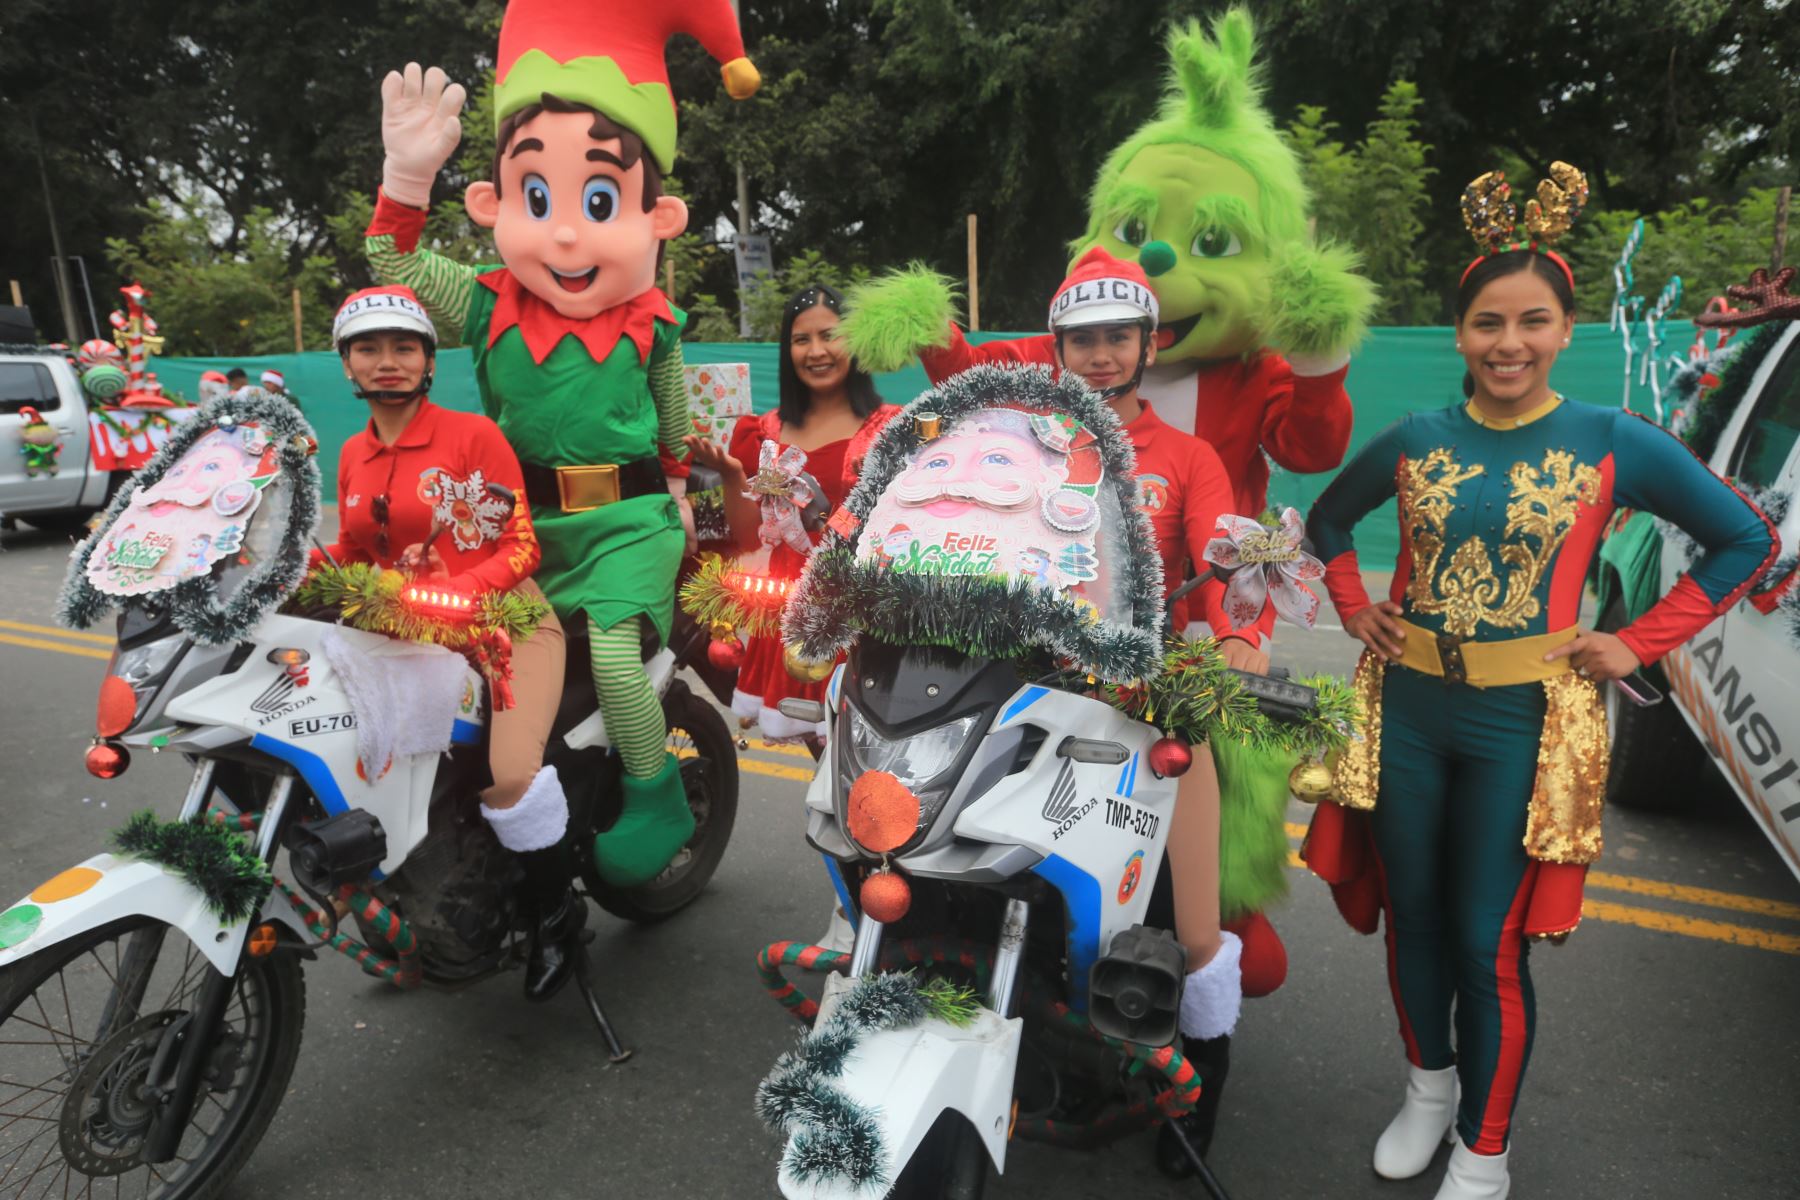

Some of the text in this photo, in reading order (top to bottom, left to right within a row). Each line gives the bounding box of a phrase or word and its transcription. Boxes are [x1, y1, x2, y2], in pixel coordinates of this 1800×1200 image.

[893, 538, 999, 576] Navidad
[942, 531, 996, 552] Feliz
[257, 695, 318, 726] HONDA
[1688, 634, 1800, 824] ANSI
[1052, 797, 1099, 841] HONDA
[1105, 798, 1160, 840] TMP-5270
